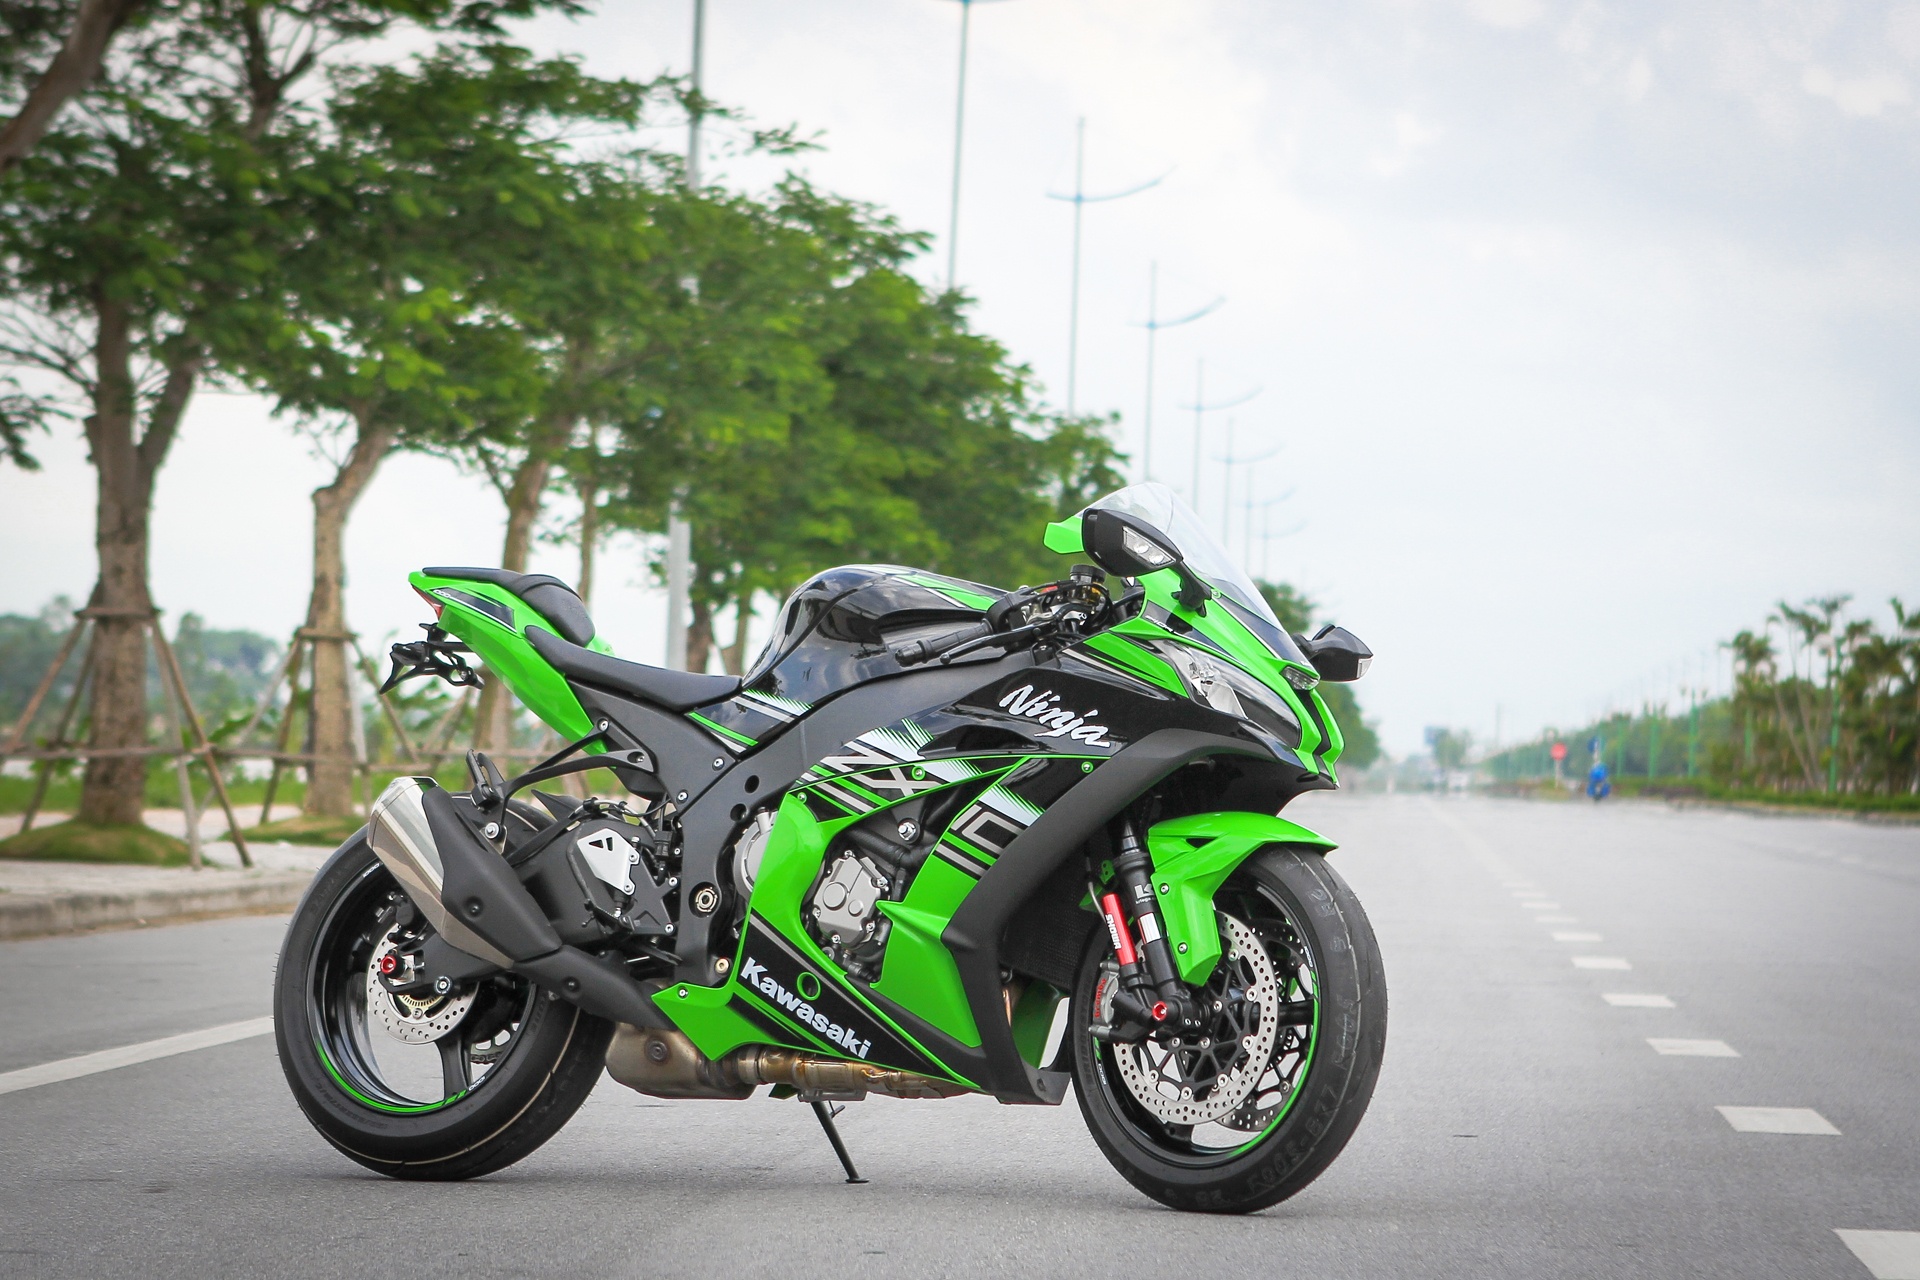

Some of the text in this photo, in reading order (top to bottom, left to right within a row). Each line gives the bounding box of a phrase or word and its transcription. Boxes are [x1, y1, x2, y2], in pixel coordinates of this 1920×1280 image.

[998, 684, 1111, 748] Ninja
[1105, 913, 1122, 950] SHOWA
[740, 957, 872, 1060] Kawasaki
[1094, 978, 1107, 1018] brembo
